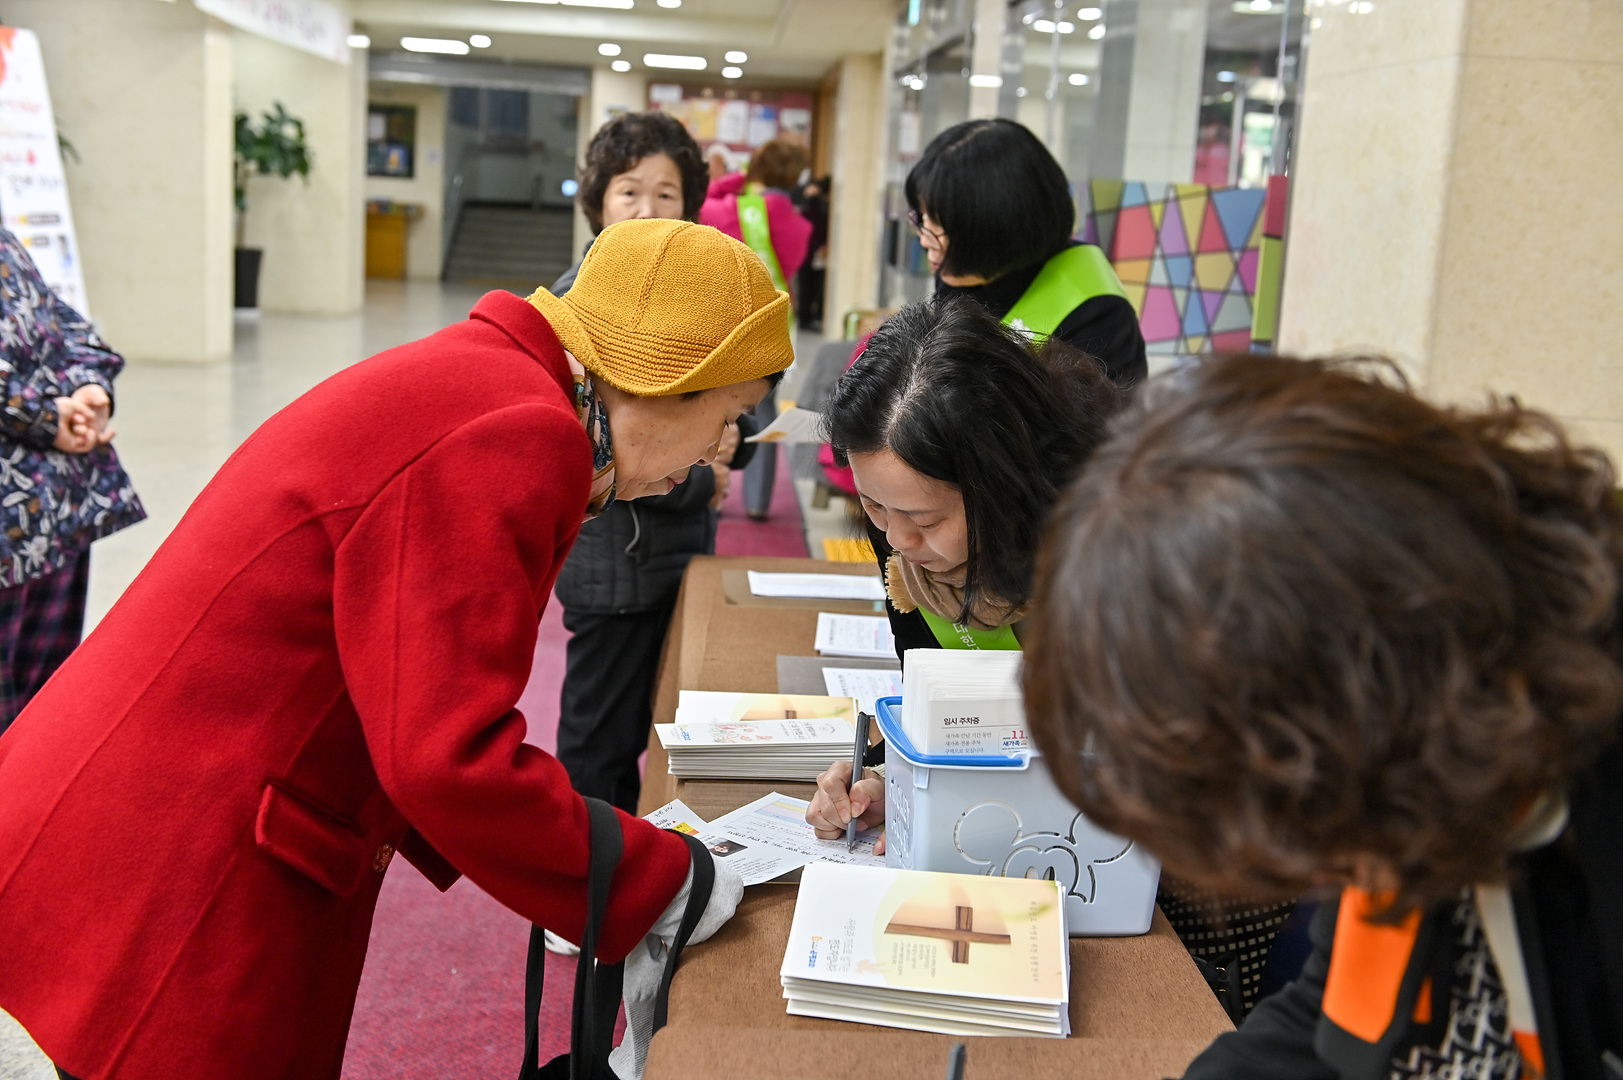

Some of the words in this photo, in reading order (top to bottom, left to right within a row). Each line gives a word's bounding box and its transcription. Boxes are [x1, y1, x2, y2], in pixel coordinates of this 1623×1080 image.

[952, 622, 981, 650] 대한
[943, 717, 958, 726] 임시
[959, 716, 980, 725] 주차증
[1011, 730, 1026, 739] 11
